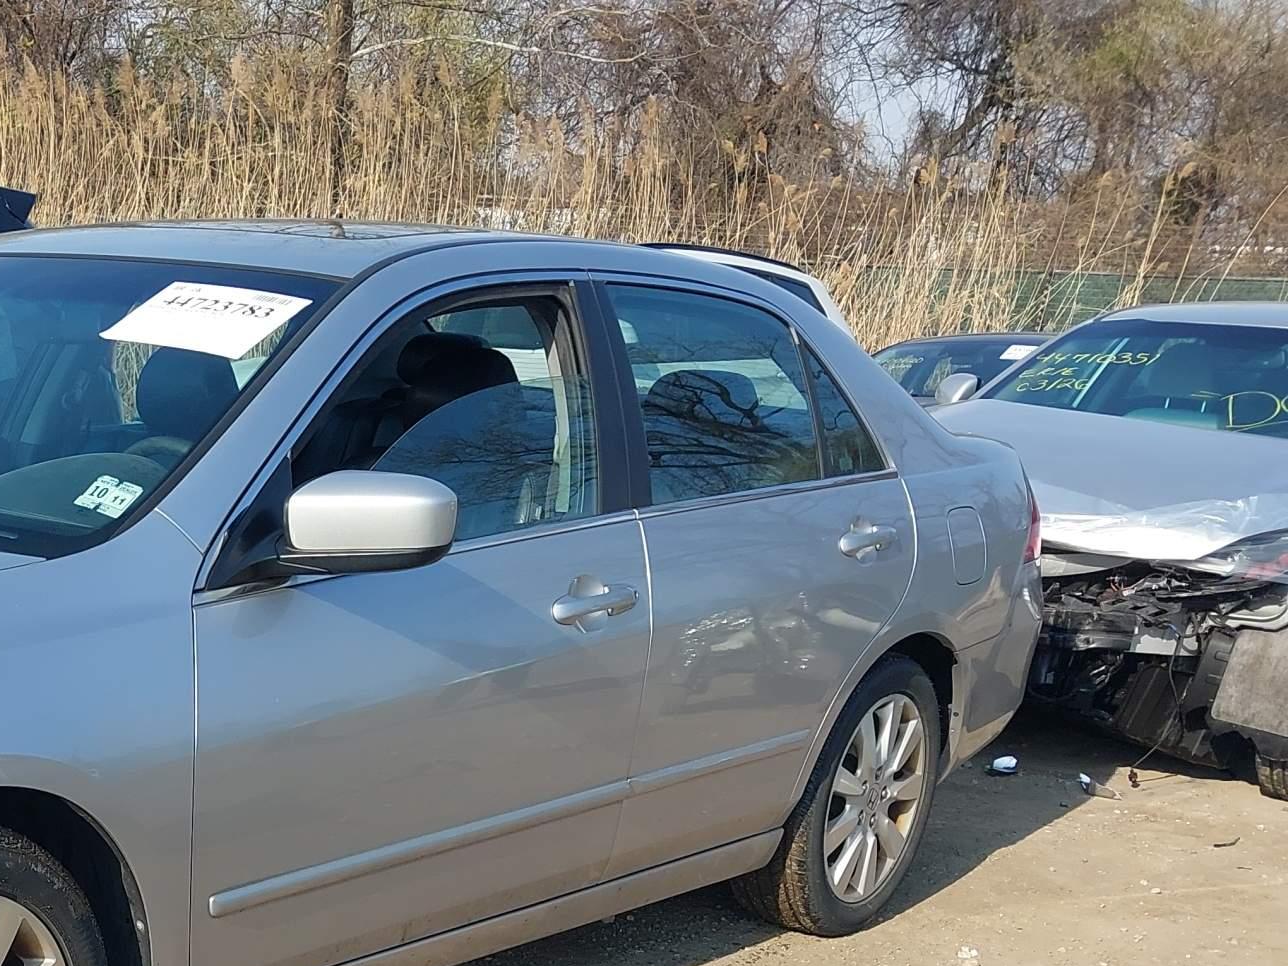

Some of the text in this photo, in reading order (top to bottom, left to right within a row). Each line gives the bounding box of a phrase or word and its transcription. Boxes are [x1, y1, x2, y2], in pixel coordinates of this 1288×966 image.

[162, 295, 275, 319] 44723783
[1018, 367, 1080, 379] ERIE
[1016, 377, 1090, 392] 03/26
[88, 485, 109, 499] 10
